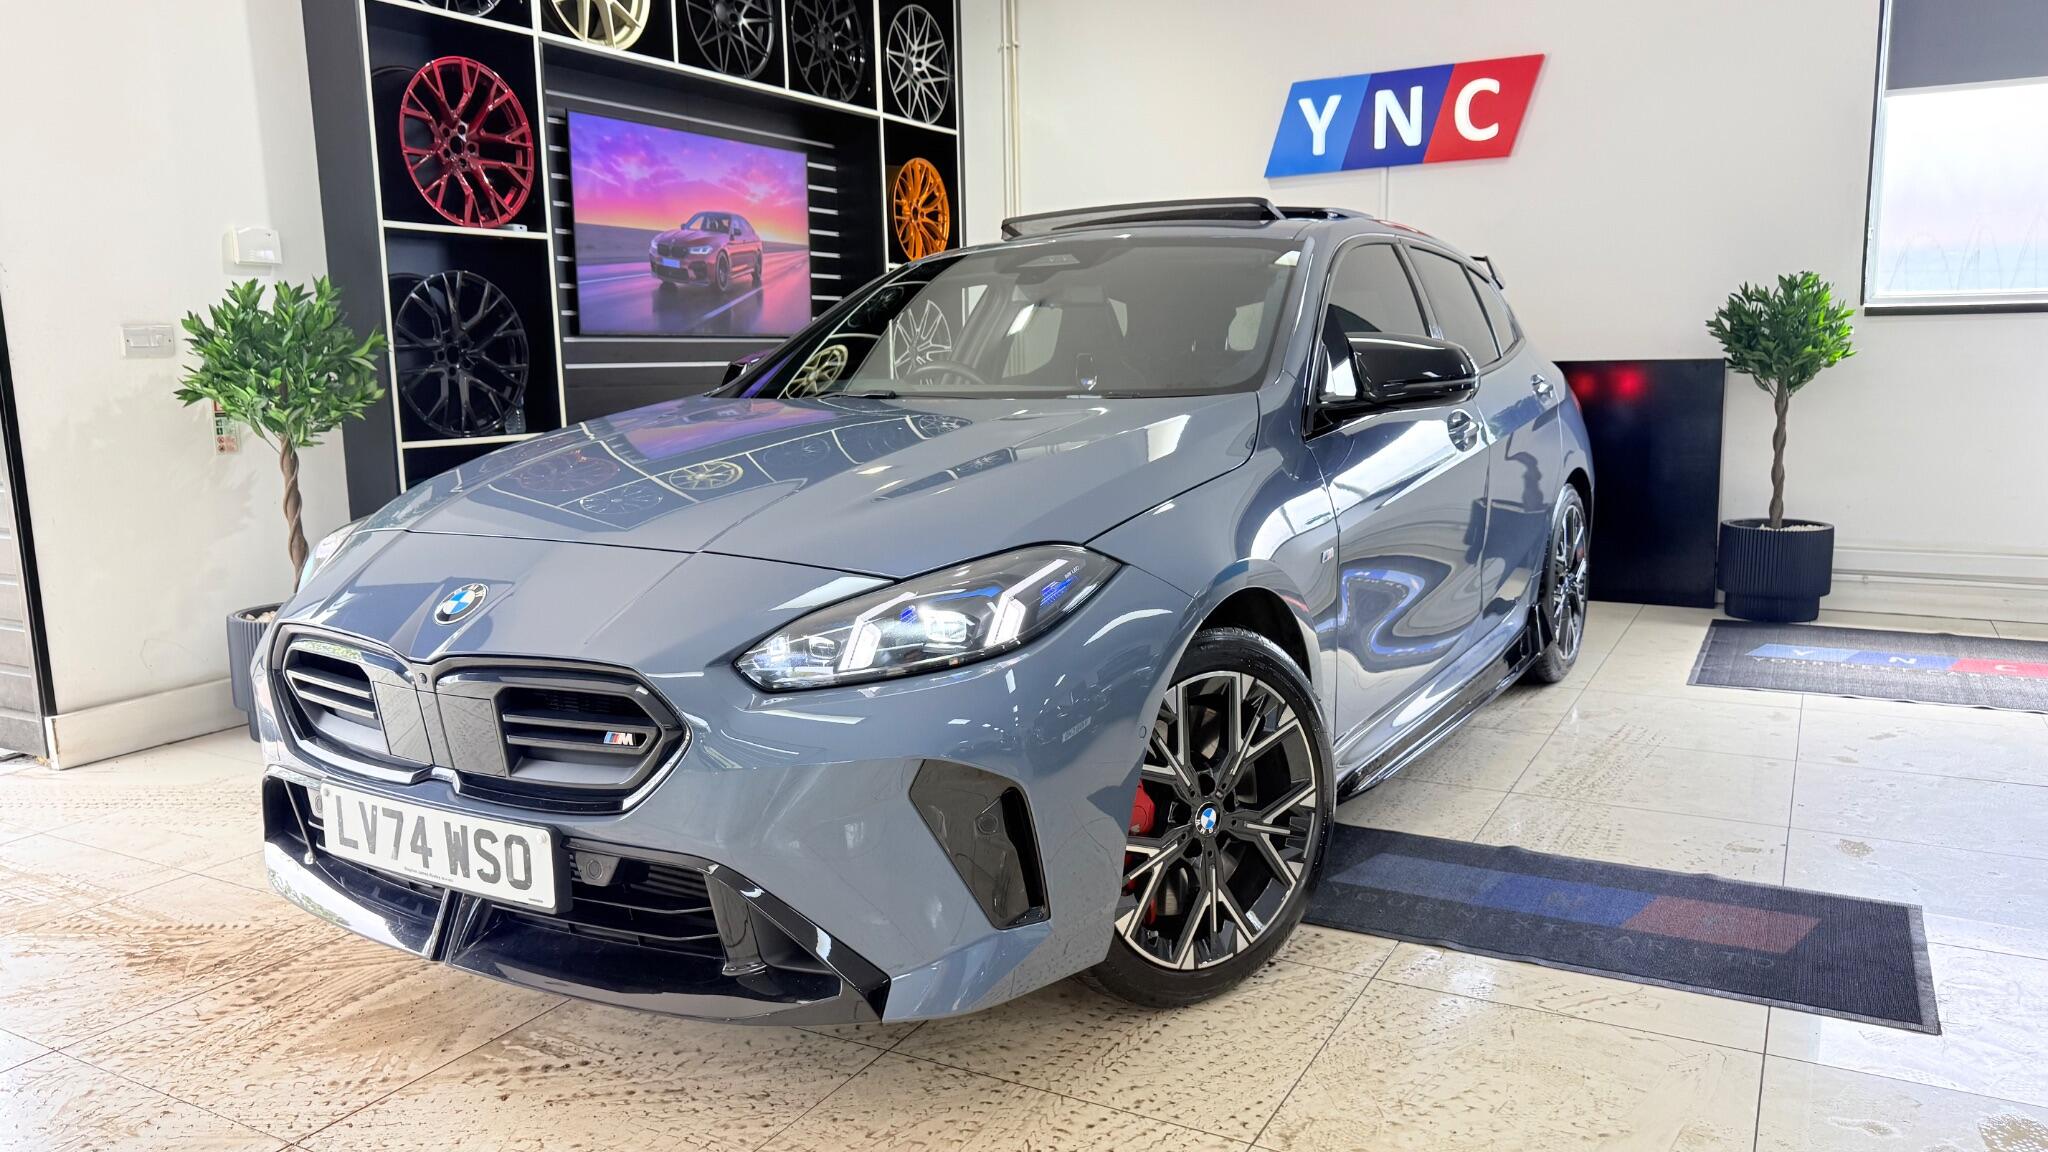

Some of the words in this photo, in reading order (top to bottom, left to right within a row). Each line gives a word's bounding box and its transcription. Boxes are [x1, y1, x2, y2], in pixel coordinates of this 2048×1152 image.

[1298, 77, 1500, 156] YNC
[1793, 648, 2018, 672] YNC
[335, 795, 433, 869] LV74
[443, 820, 533, 891] WSO
